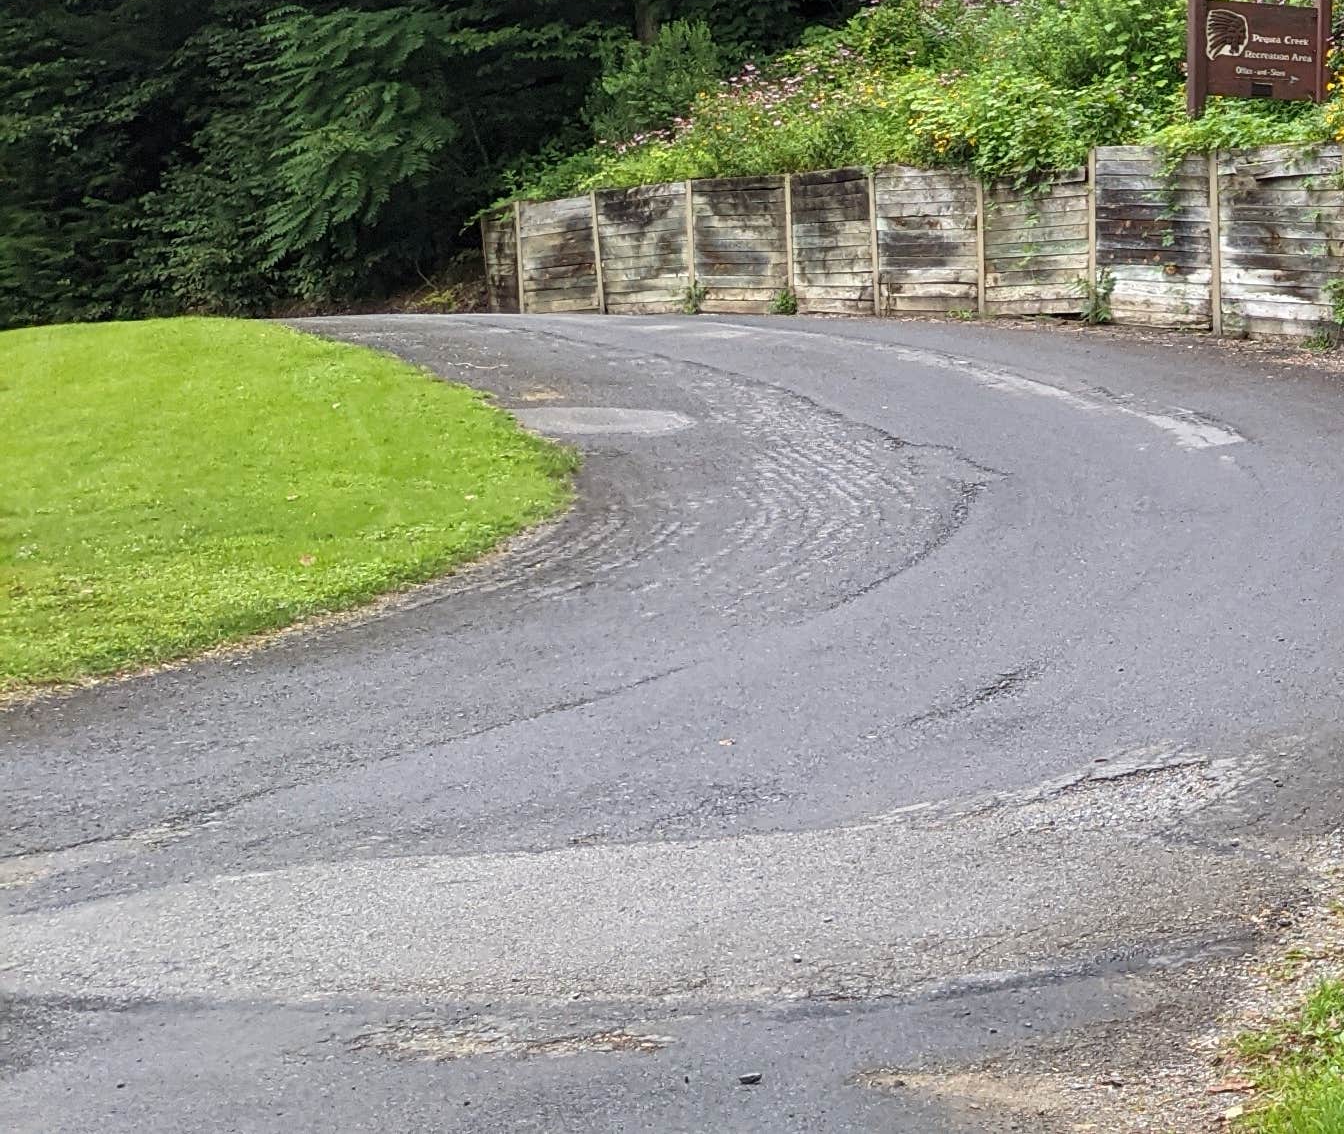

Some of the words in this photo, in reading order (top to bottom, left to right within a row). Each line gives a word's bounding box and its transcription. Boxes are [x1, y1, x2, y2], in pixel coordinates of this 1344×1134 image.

[1284, 36, 1310, 46] Creek
[1244, 50, 1290, 61] Recreation
[1292, 53, 1312, 62] Area
